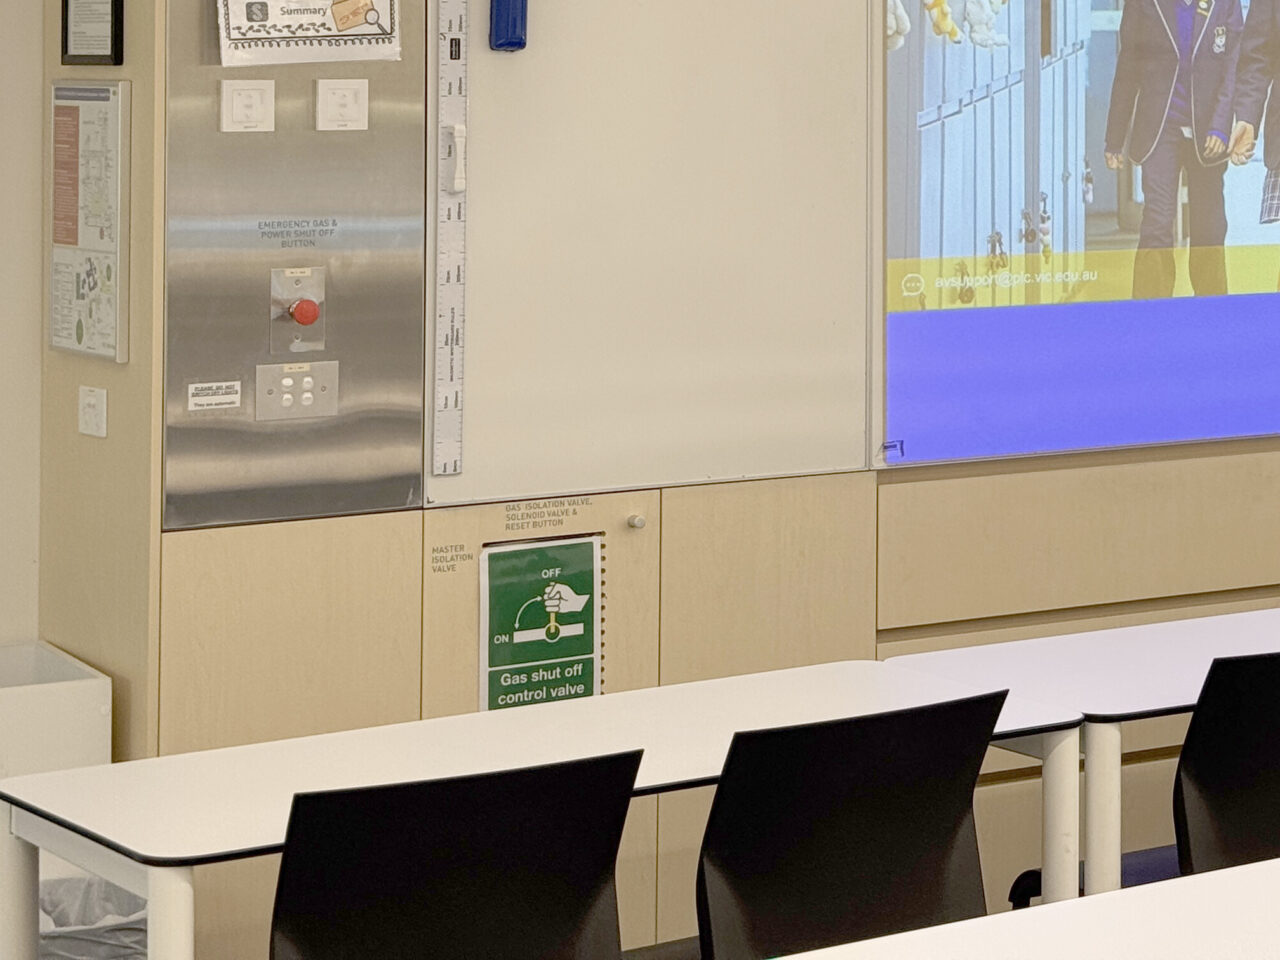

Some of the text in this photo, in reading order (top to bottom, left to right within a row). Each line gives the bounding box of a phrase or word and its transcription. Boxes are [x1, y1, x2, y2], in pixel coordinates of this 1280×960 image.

[251, 4, 263, 21] S
[280, 6, 327, 17] Summary
[258, 220, 311, 229] EMERGENCY
[313, 219, 329, 227] GAS
[261, 228, 335, 239] POWER SHUT OFF
[281, 240, 316, 248] BUTTON
[506, 504, 521, 512] GAS
[525, 501, 565, 510] ISOLATION
[506, 512, 545, 521] SOLENOID
[546, 510, 569, 518] VALVE
[506, 519, 564, 531] RESET BUTTON
[432, 545, 465, 554] MASTER
[432, 554, 473, 564] ISOLATION
[432, 564, 456, 573] VALVE
[541, 568, 562, 578] OFF
[494, 634, 509, 644] ON
[501, 663, 583, 686] Gas shut off
[498, 682, 585, 705] control valve
